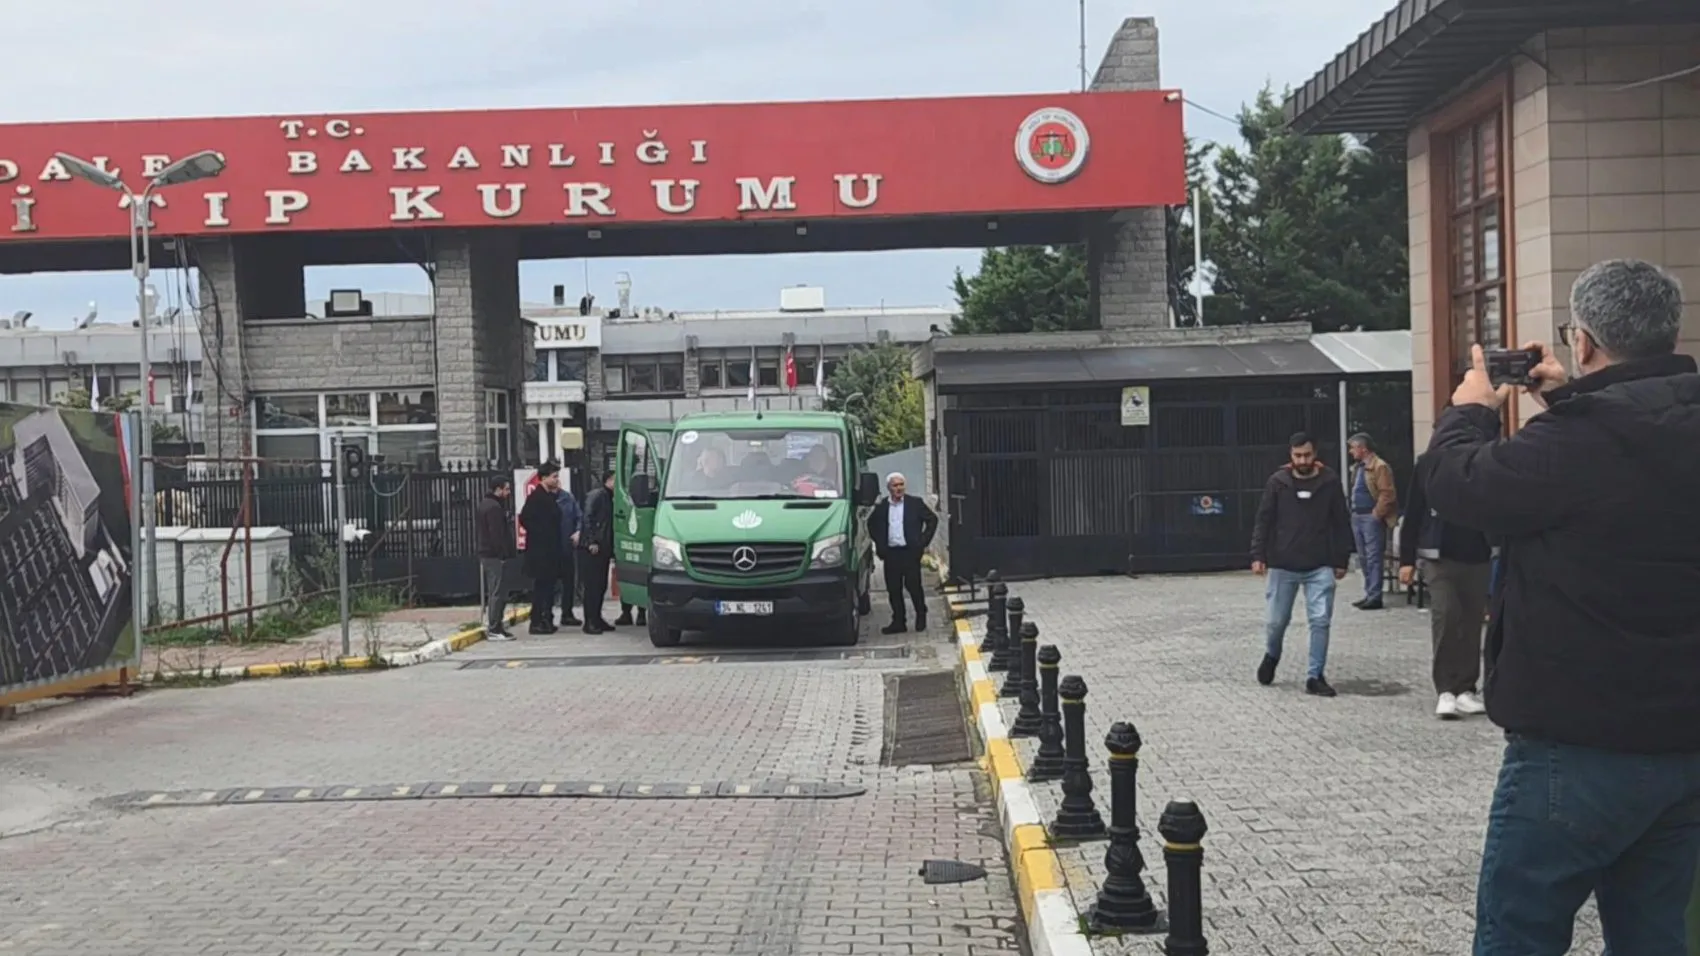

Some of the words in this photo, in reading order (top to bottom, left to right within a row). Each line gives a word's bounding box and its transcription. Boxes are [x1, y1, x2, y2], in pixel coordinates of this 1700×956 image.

[280, 119, 366, 139] T.C.
[0, 152, 226, 181] DALE
[287, 128, 709, 174] BAKANLIĞI
[118, 189, 310, 228] TIP
[388, 173, 884, 221] KURUMU
[534, 323, 587, 341] UMU
